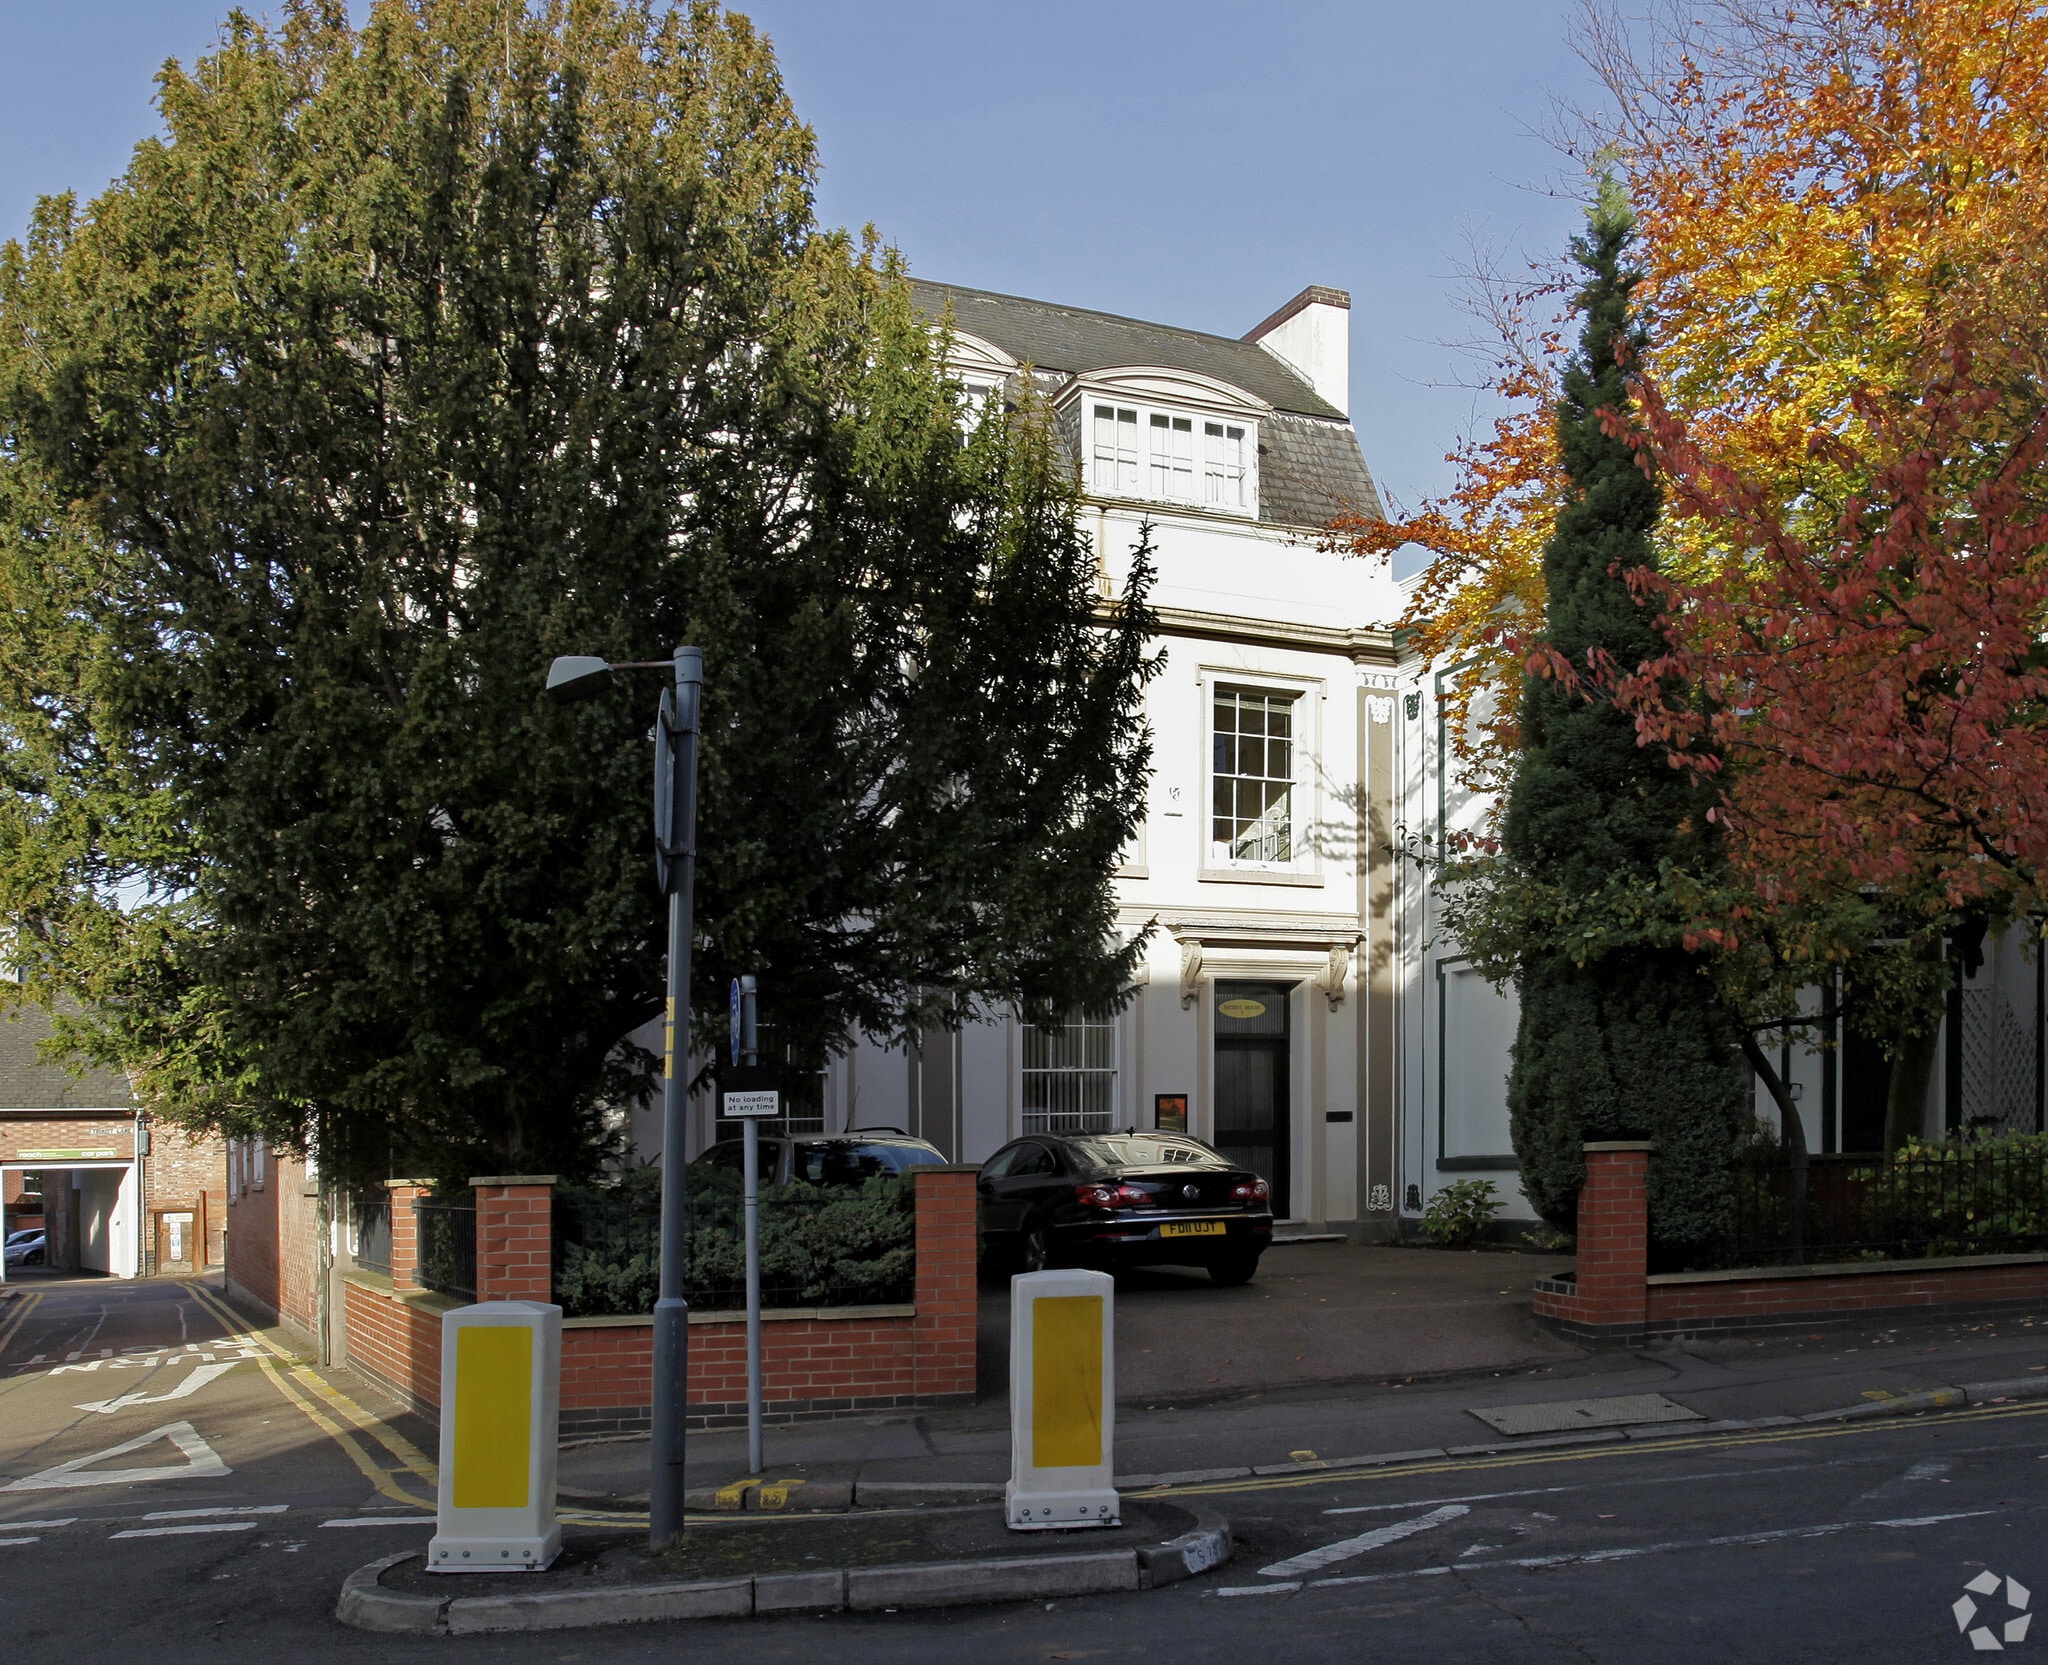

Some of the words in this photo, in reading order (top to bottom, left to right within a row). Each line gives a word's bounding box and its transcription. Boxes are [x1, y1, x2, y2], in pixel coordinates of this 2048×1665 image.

[95, 1150, 115, 1158] park
[8, 1337, 260, 1367] RIGHT
[48, 1349, 275, 1376] TURN
